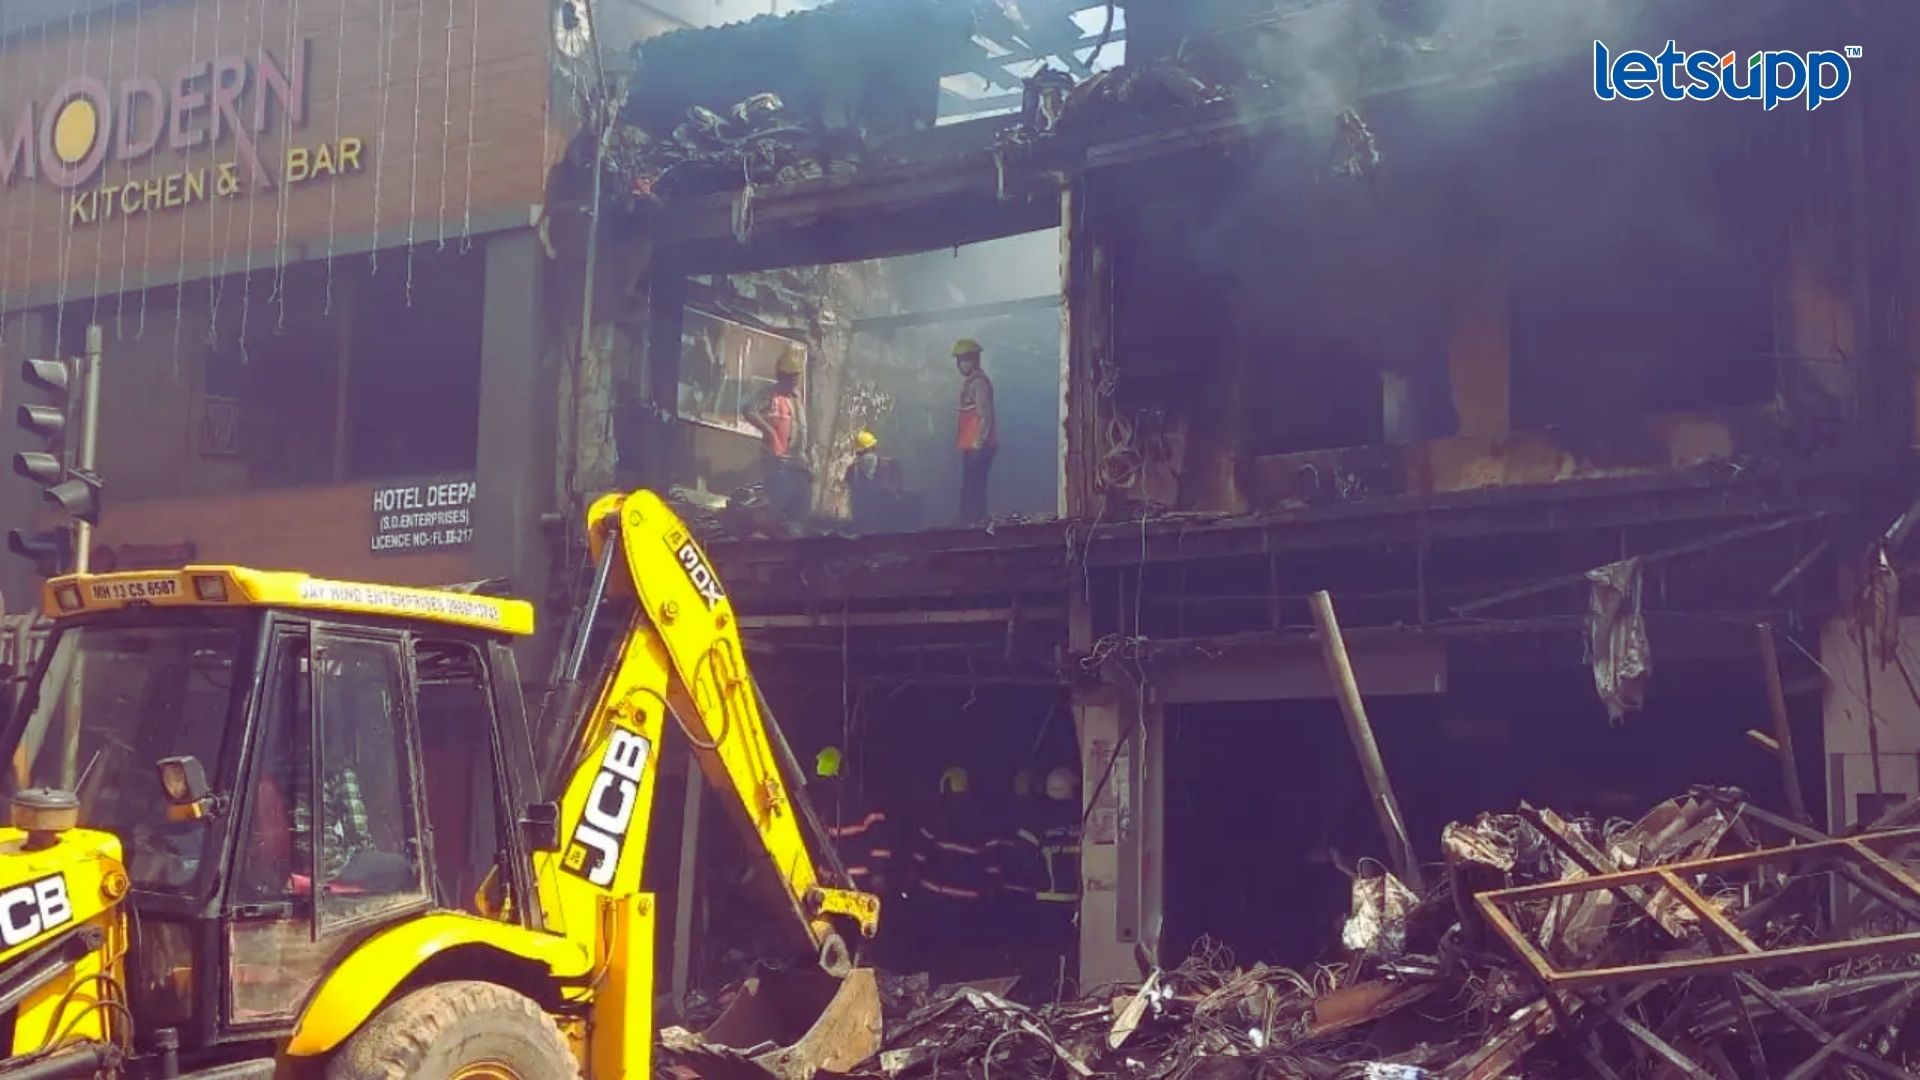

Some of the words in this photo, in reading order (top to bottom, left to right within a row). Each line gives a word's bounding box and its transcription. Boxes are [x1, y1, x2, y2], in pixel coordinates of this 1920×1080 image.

[69, 170, 205, 225] KITCHEN
[217, 162, 240, 196] &
[286, 137, 362, 183] BAR
[373, 487, 424, 511] HOTEL
[427, 482, 477, 506] DEEPA
[371, 533, 412, 550] LICENCE
[93, 584, 110, 599] MH
[129, 582, 145, 597] CS
[679, 543, 726, 611] 3DX
[574, 728, 651, 886] JCB
